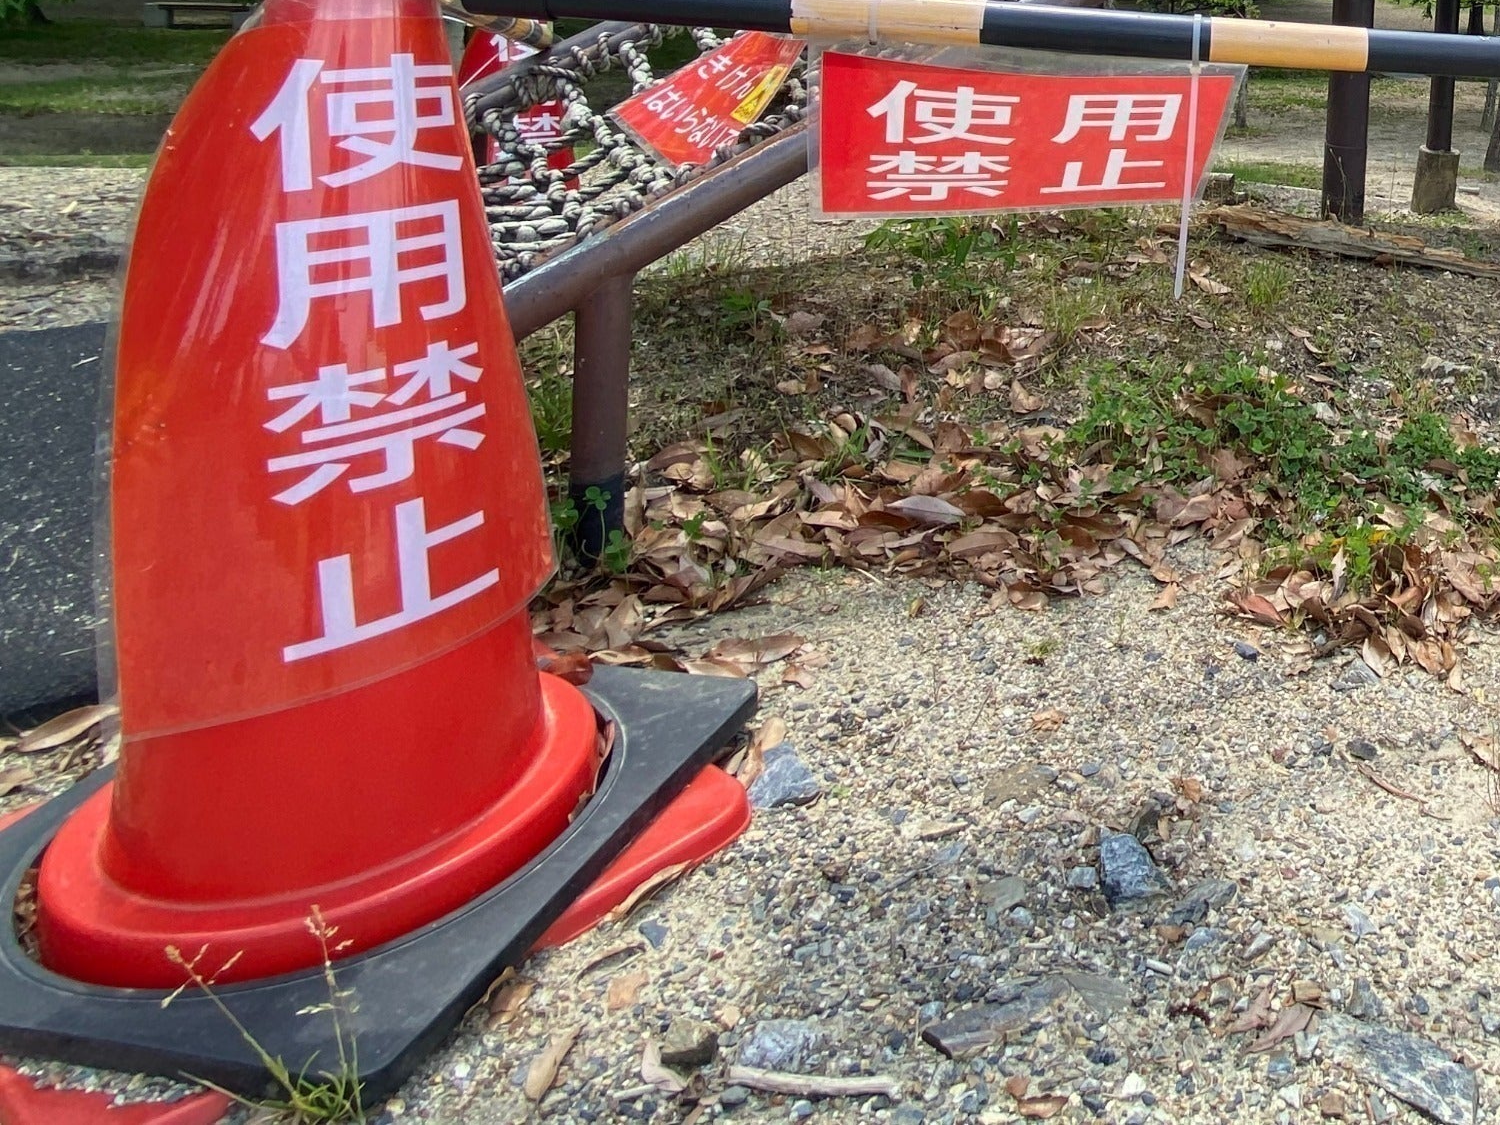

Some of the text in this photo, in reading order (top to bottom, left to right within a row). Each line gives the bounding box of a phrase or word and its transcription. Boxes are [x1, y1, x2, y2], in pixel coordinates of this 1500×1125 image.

[697, 54, 763, 100] きけん
[865, 79, 1184, 146] 使用
[865, 148, 1167, 202] 禁止
[249, 53, 500, 663] 使用禁止
